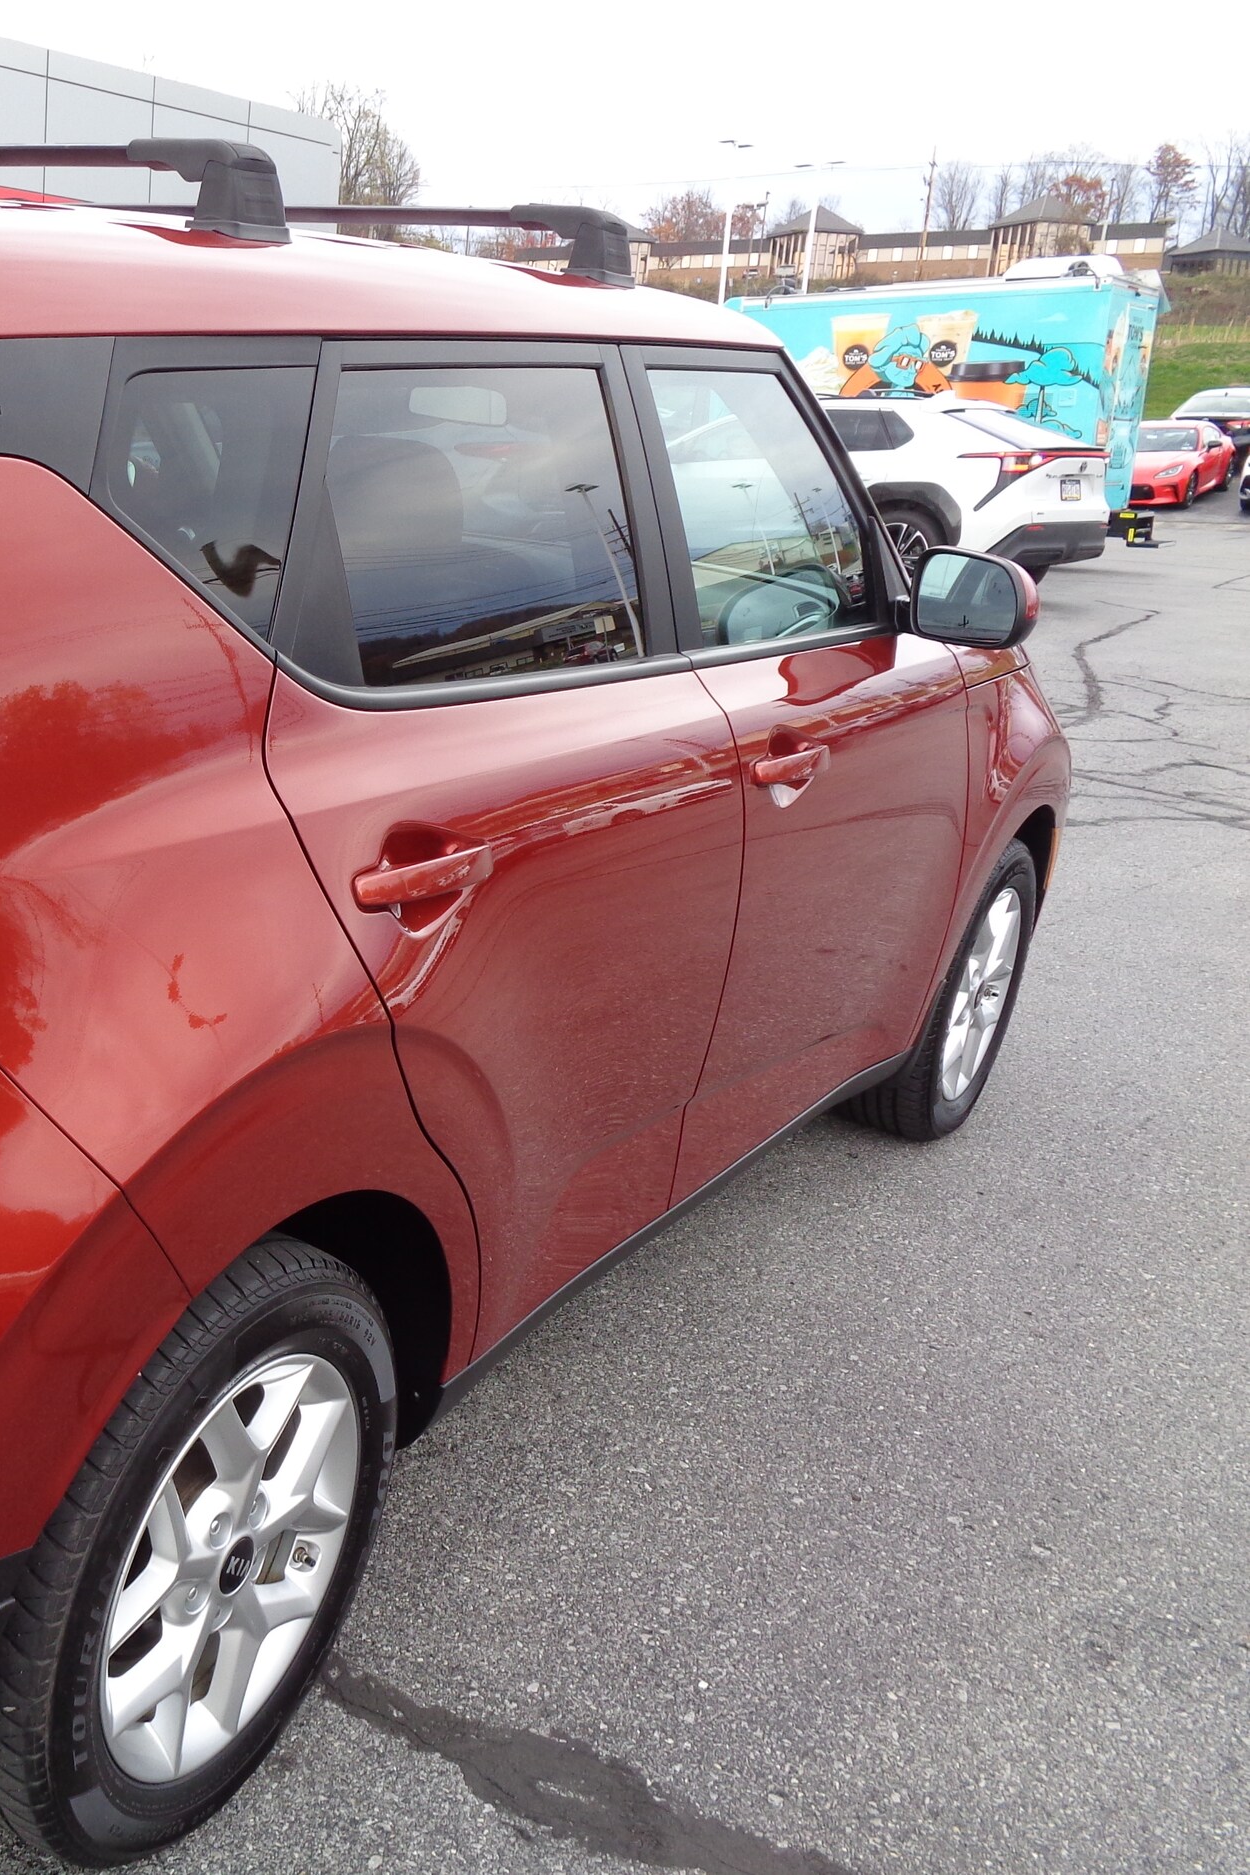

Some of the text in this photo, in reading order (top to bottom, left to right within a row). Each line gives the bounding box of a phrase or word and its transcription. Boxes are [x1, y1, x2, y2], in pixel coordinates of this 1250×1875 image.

[845, 354, 868, 362] TOM'S
[931, 350, 955, 359] TOM'S
[226, 1555, 250, 1577] KIA
